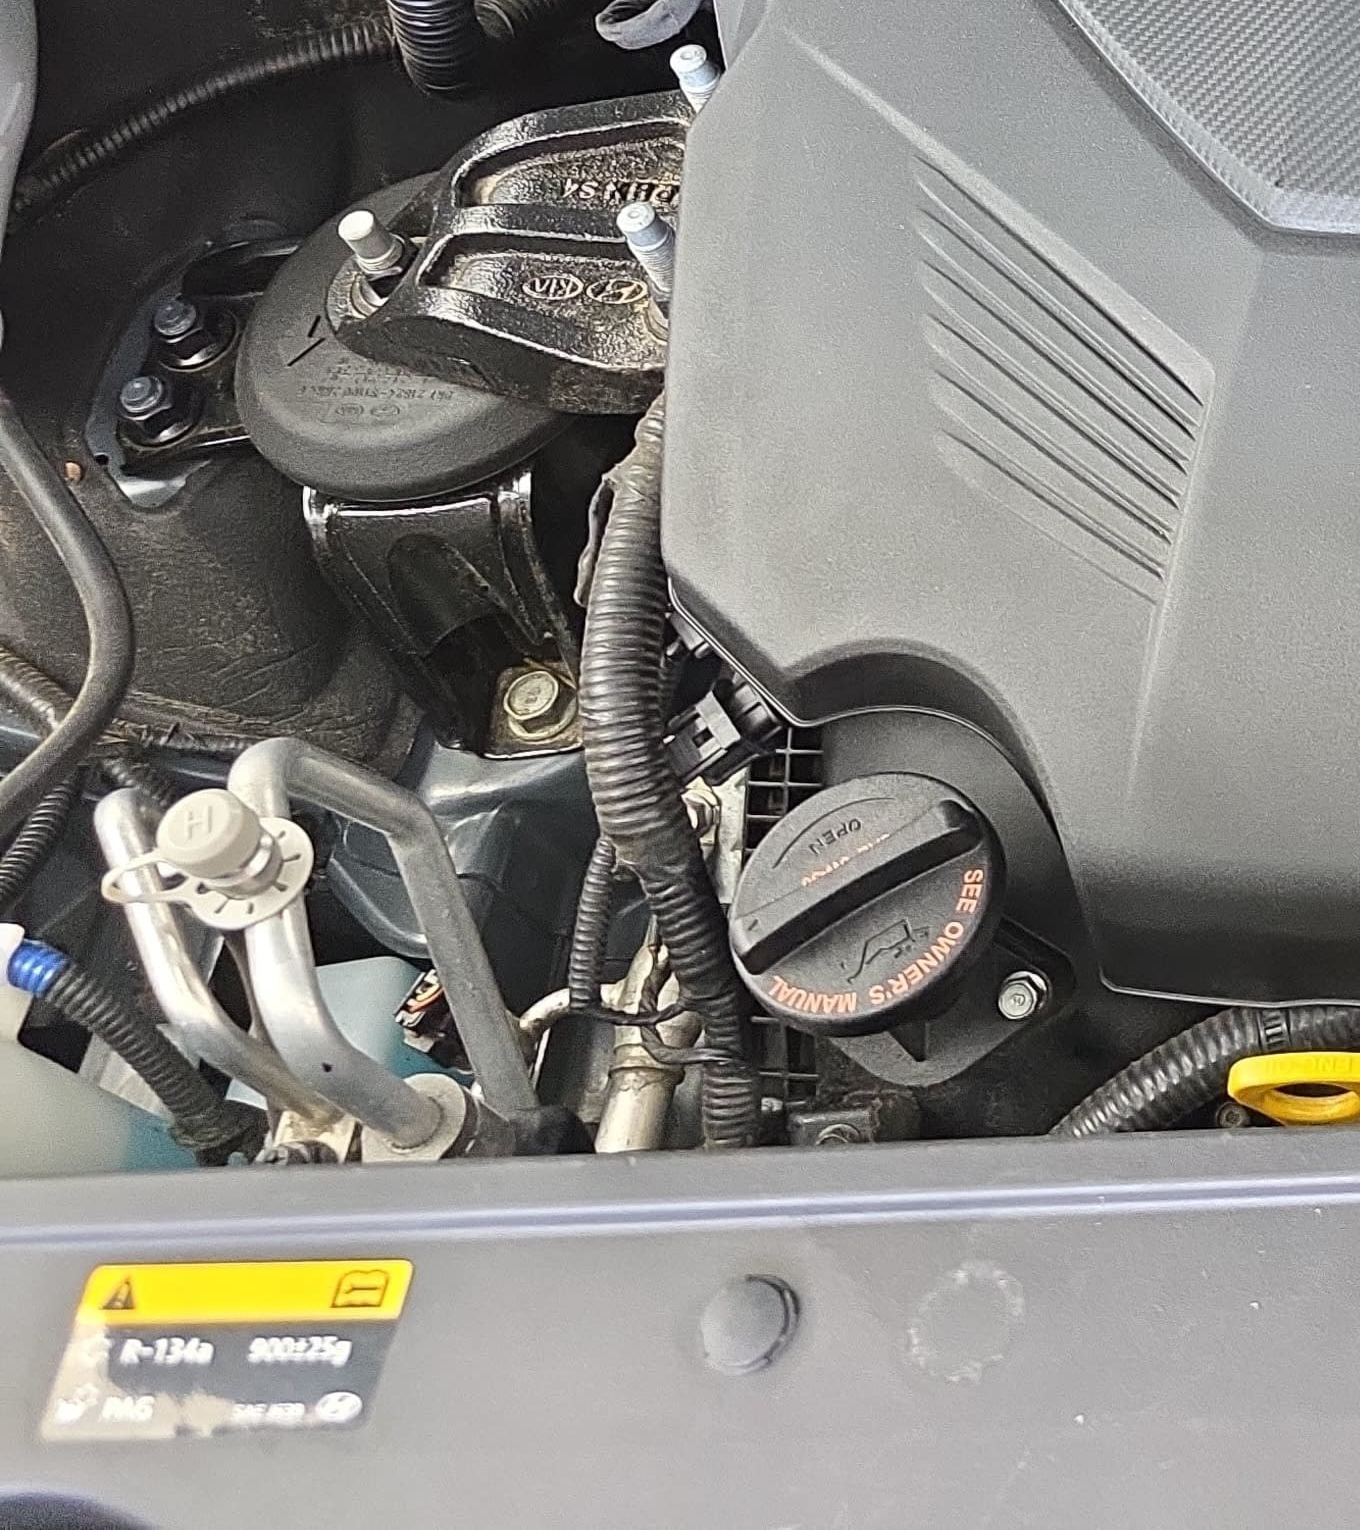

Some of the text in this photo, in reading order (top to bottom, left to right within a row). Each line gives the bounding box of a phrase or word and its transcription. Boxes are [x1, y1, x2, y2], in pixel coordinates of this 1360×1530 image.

[809, 817, 862, 856] OPEN
[767, 868, 984, 1014] SEE OWNER'S MANUAL
[119, 1336, 214, 1366] R-134a
